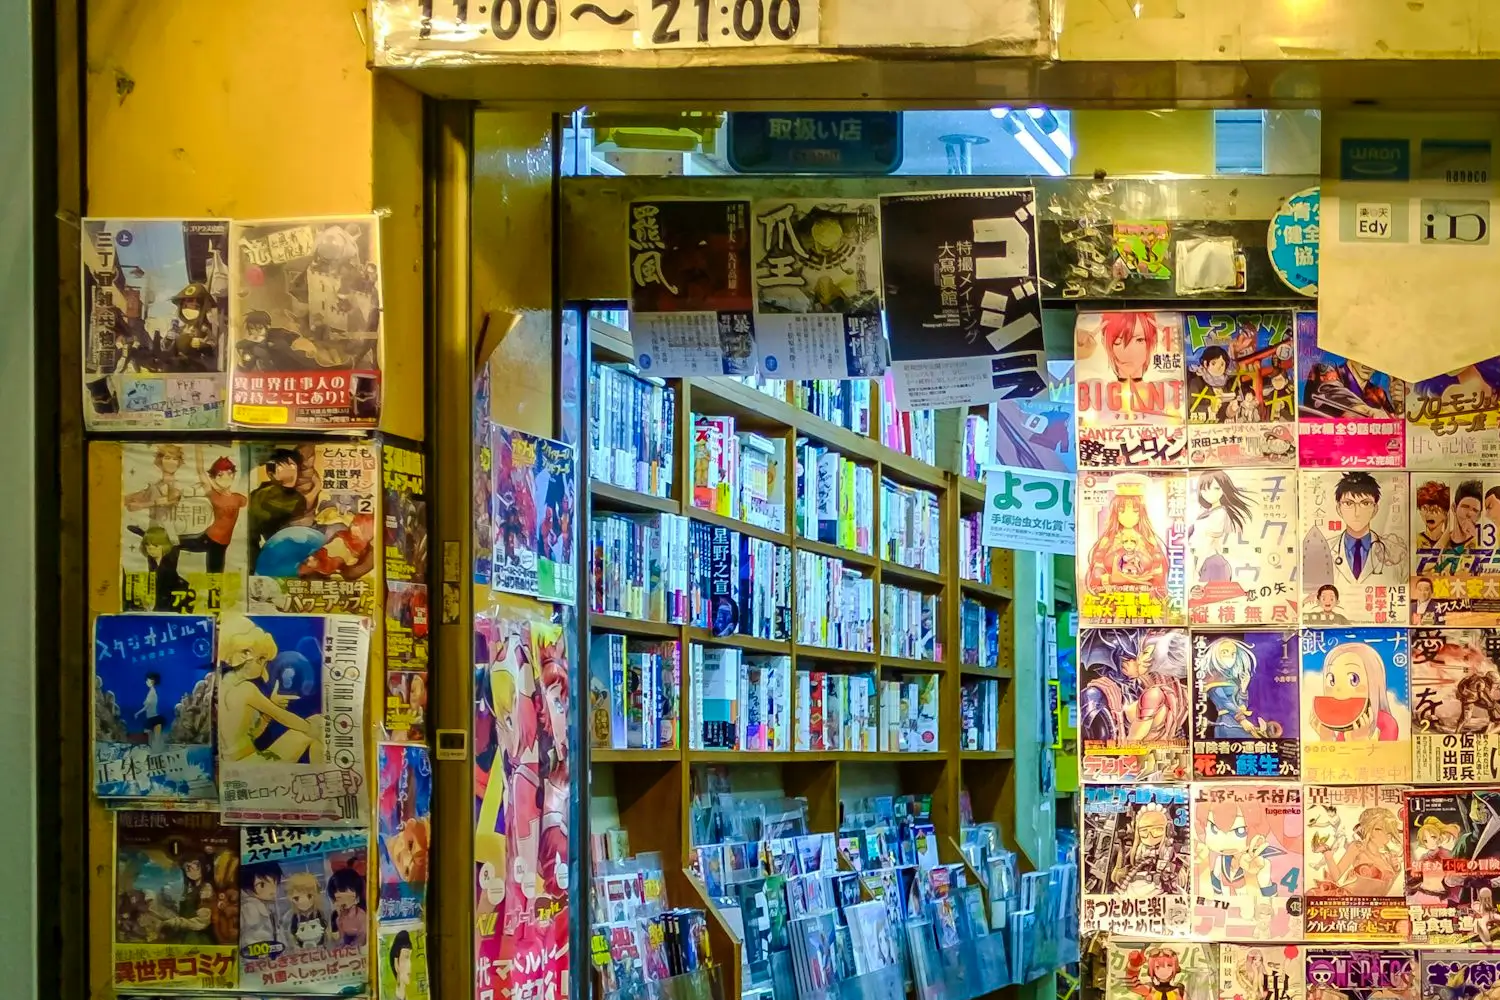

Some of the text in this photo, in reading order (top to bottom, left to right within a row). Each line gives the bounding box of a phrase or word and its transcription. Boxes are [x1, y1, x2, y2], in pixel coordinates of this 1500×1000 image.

[1446, 171, 1488, 183] nanaco
[1359, 220, 1388, 236] Edy
[1424, 213, 1487, 241] iD
[955, 241, 979, 345] 特撮メイキング
[323, 448, 371, 458] とんでも
[323, 469, 361, 478] 異世界
[360, 501, 370, 512] 2
[1475, 523, 1496, 547] 13
[712, 527, 729, 596] 星野之宣
[310, 580, 368, 595] 黒毛和牛
[1194, 742, 1277, 754] 冒険者の運命は
[1443, 735, 1458, 781] の出現
[1460, 735, 1475, 781] 仮面兵
[1194, 755, 1300, 776] 死か、蘇生か。
[1174, 809, 1187, 827] 3
[1280, 867, 1300, 893] 4
[116, 956, 235, 983] 異世界コミケ
